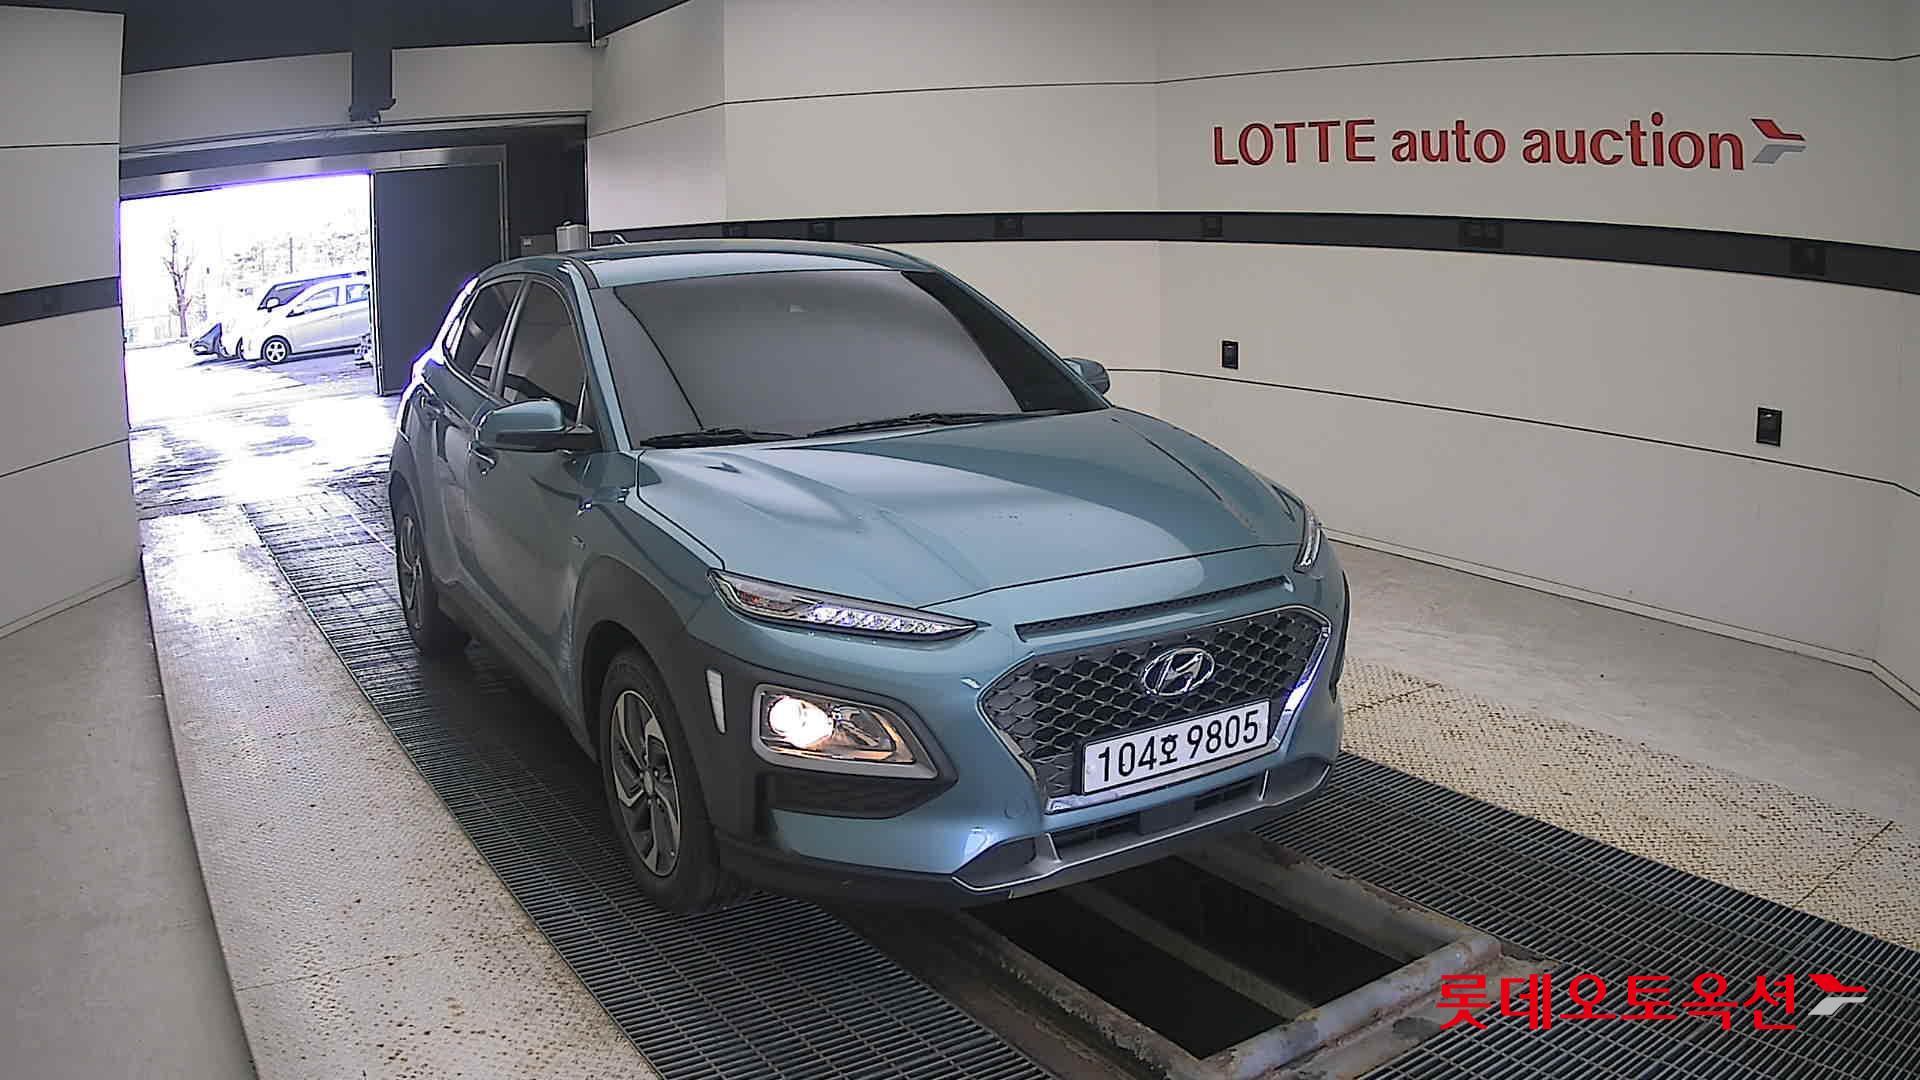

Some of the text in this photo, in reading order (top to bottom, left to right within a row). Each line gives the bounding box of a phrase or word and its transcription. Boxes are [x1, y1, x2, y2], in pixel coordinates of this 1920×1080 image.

[1212, 111, 1745, 171] LOTTE auto auction
[1097, 709, 1259, 783] 104호 9805
